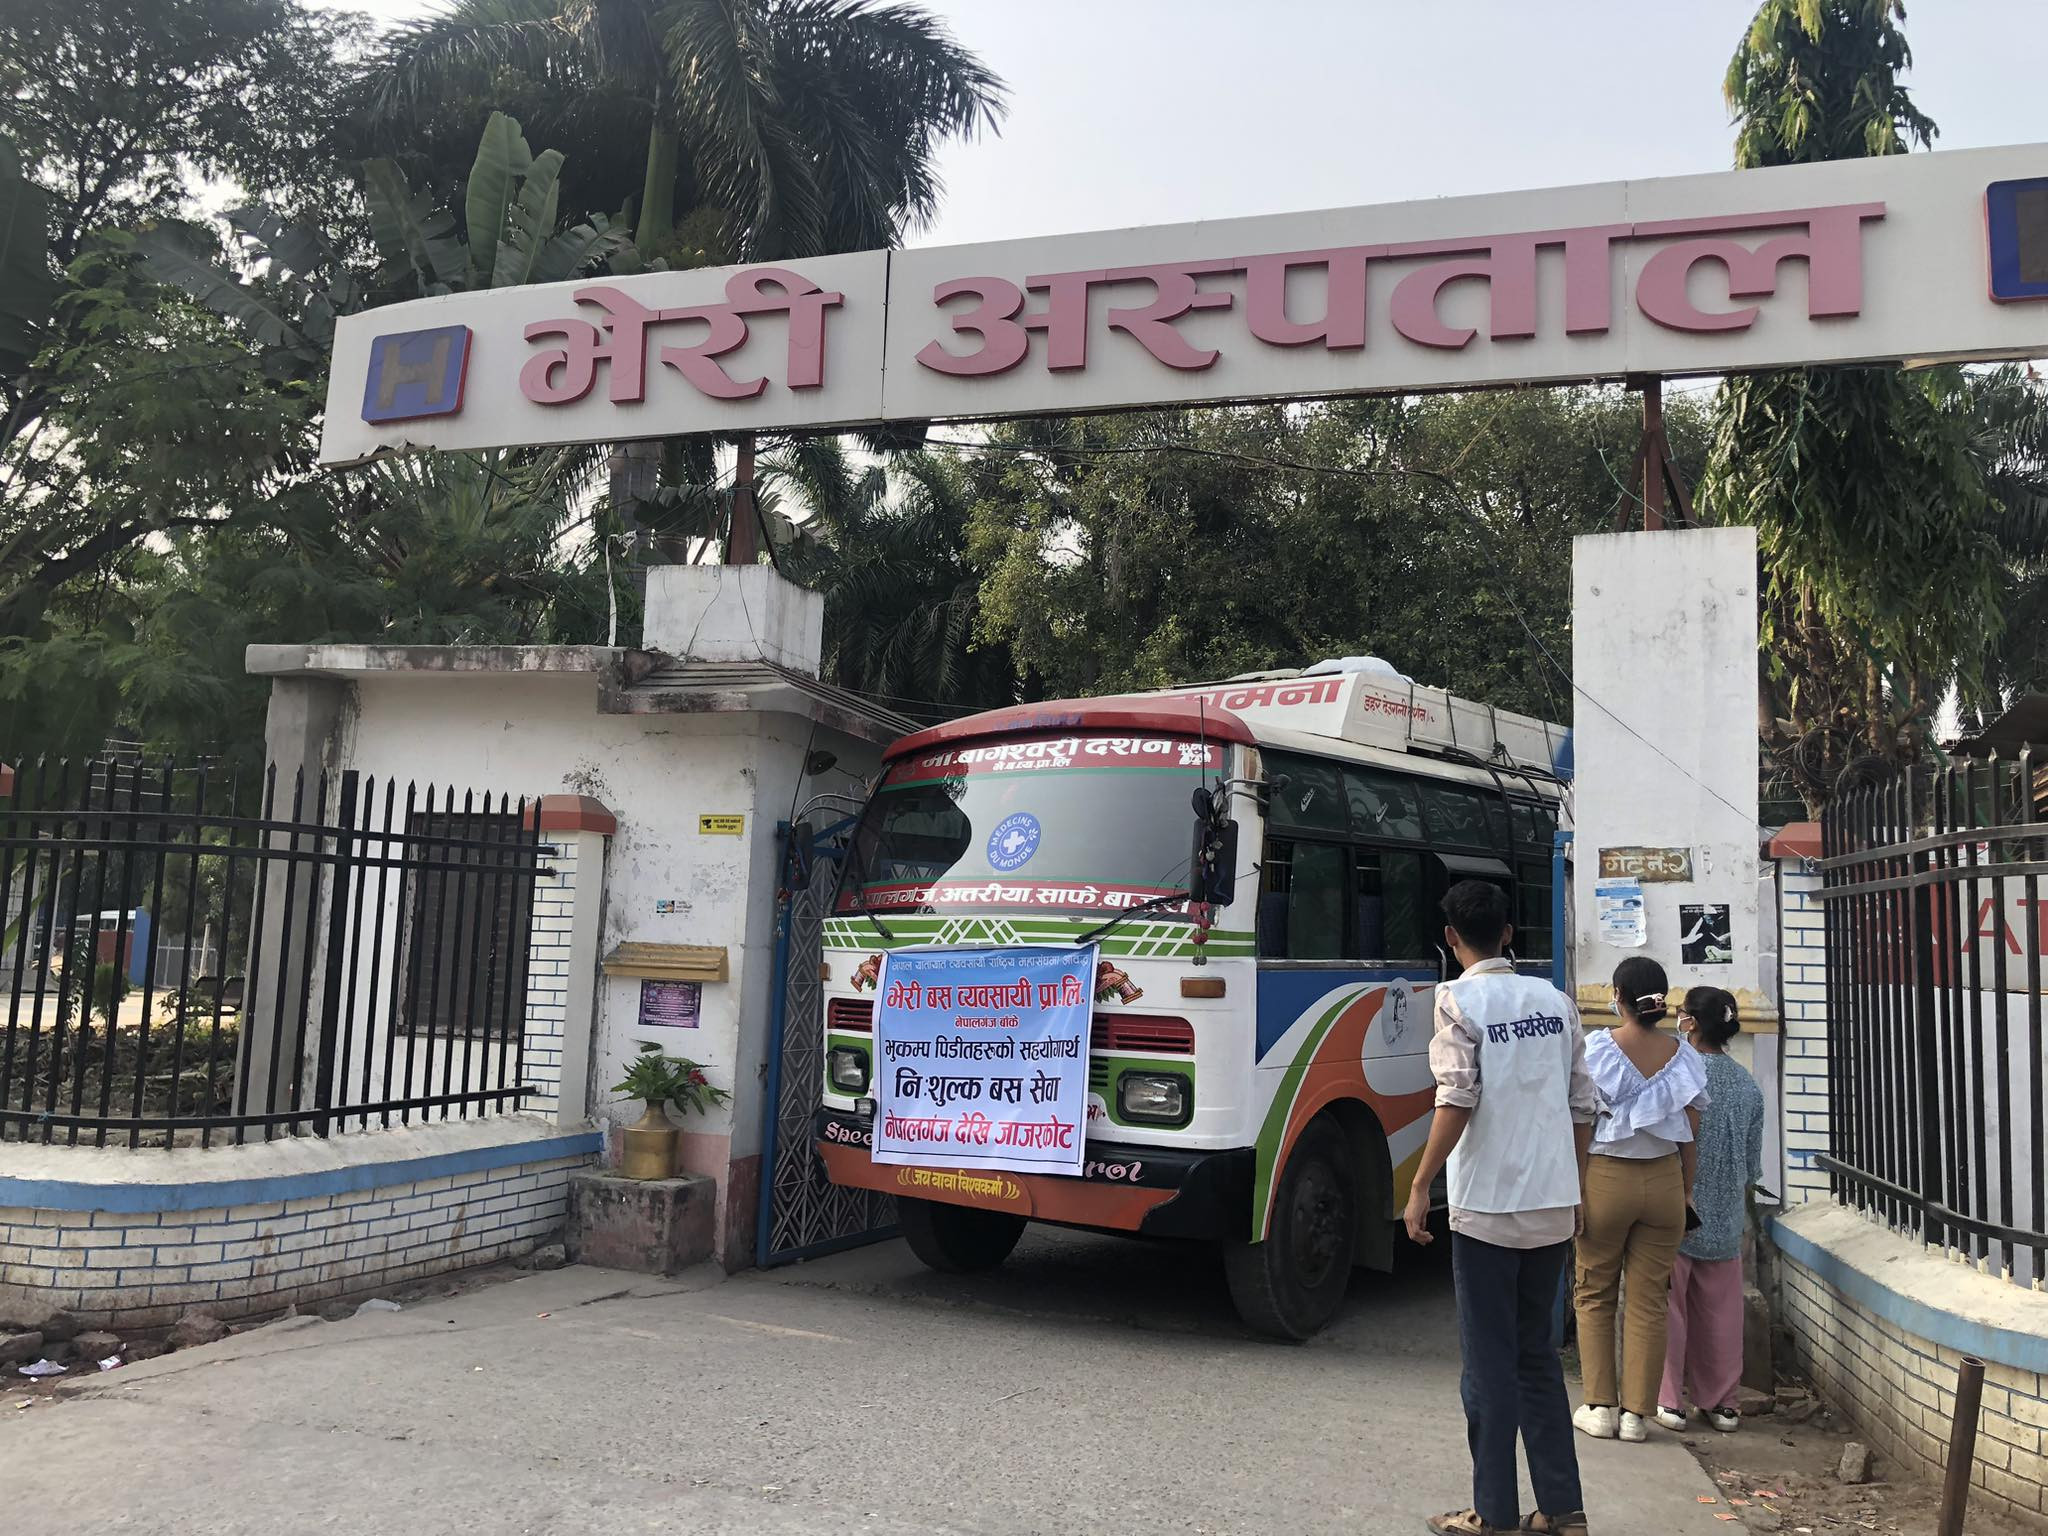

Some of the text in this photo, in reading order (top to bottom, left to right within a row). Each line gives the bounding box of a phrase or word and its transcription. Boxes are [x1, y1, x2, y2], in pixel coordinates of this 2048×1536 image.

[518, 266, 844, 405] भेरी
[914, 200, 1886, 376] अस्पताल
[375, 337, 451, 408] H
[990, 846, 1033, 868] DU MONDE
[886, 974, 1085, 1011] भेरी बस व्यवसायी प्रा.लि.
[954, 1015, 997, 1028] नेपालगंज
[885, 1039, 931, 1062] भुकम्प
[1019, 1035, 1080, 1061] सहयोगार्थ
[989, 1077, 1024, 1102] बस
[1030, 1069, 1061, 1104] सेवा
[825, 1121, 873, 1146] Spee
[885, 1109, 1075, 1149] नेपालगंज देखि जाजरकोट
